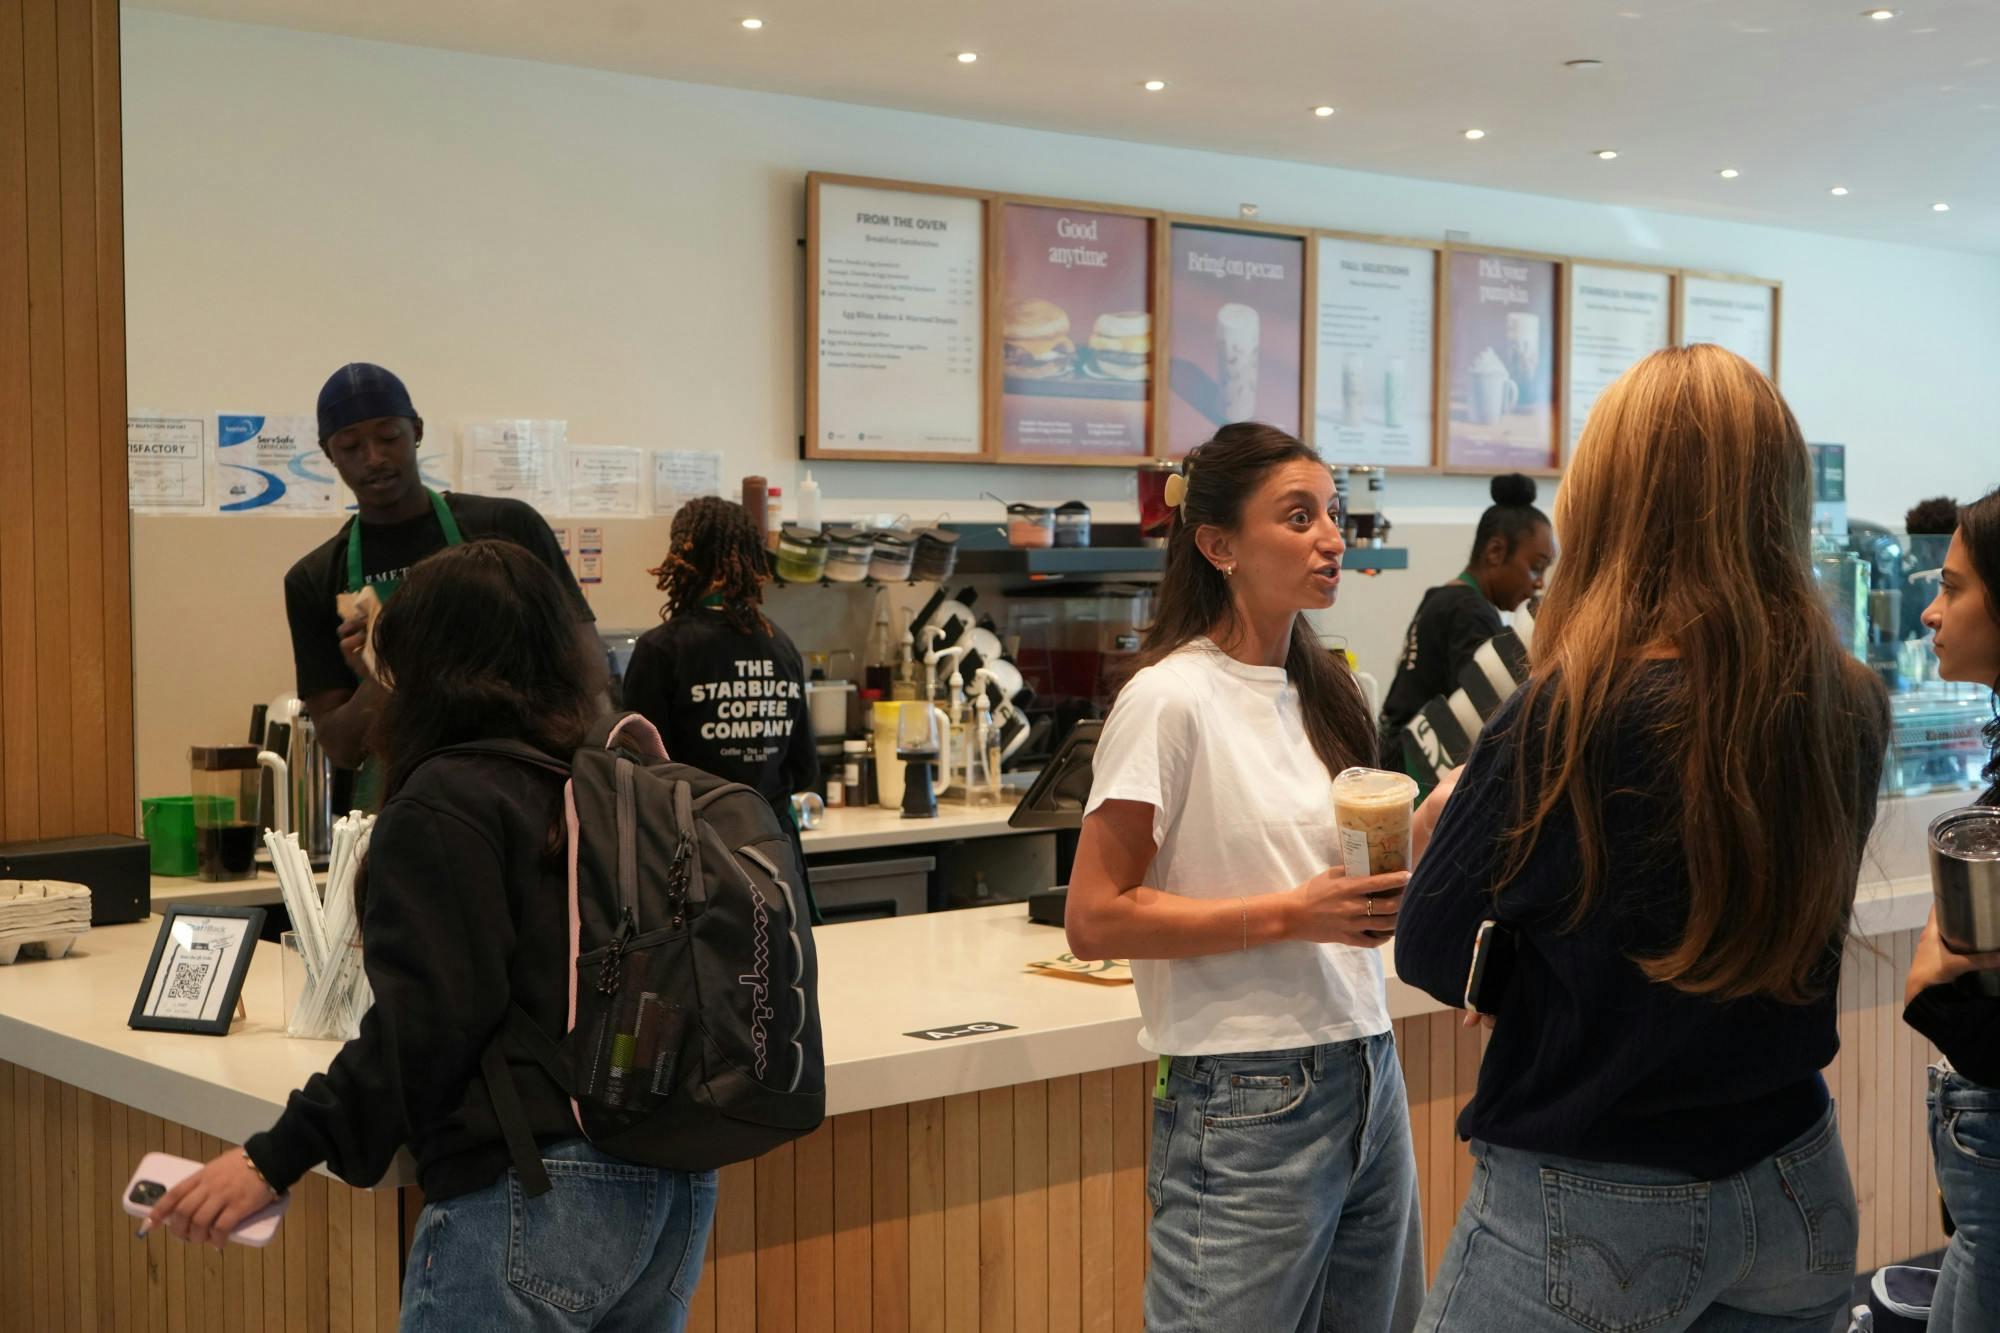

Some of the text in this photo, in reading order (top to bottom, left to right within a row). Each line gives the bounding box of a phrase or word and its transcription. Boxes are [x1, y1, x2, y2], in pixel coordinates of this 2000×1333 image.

[857, 213, 947, 231] FROM THE OVEN
[1057, 218, 1098, 241] Good
[1049, 245, 1108, 268] anytime
[1188, 251, 1285, 280] Bring on pecan
[257, 435, 295, 444] ServSafe
[735, 660, 774, 677] THE
[691, 680, 800, 702] STARBUCK
[717, 701, 788, 719] COFFEE
[701, 719, 794, 740] COMPANY
